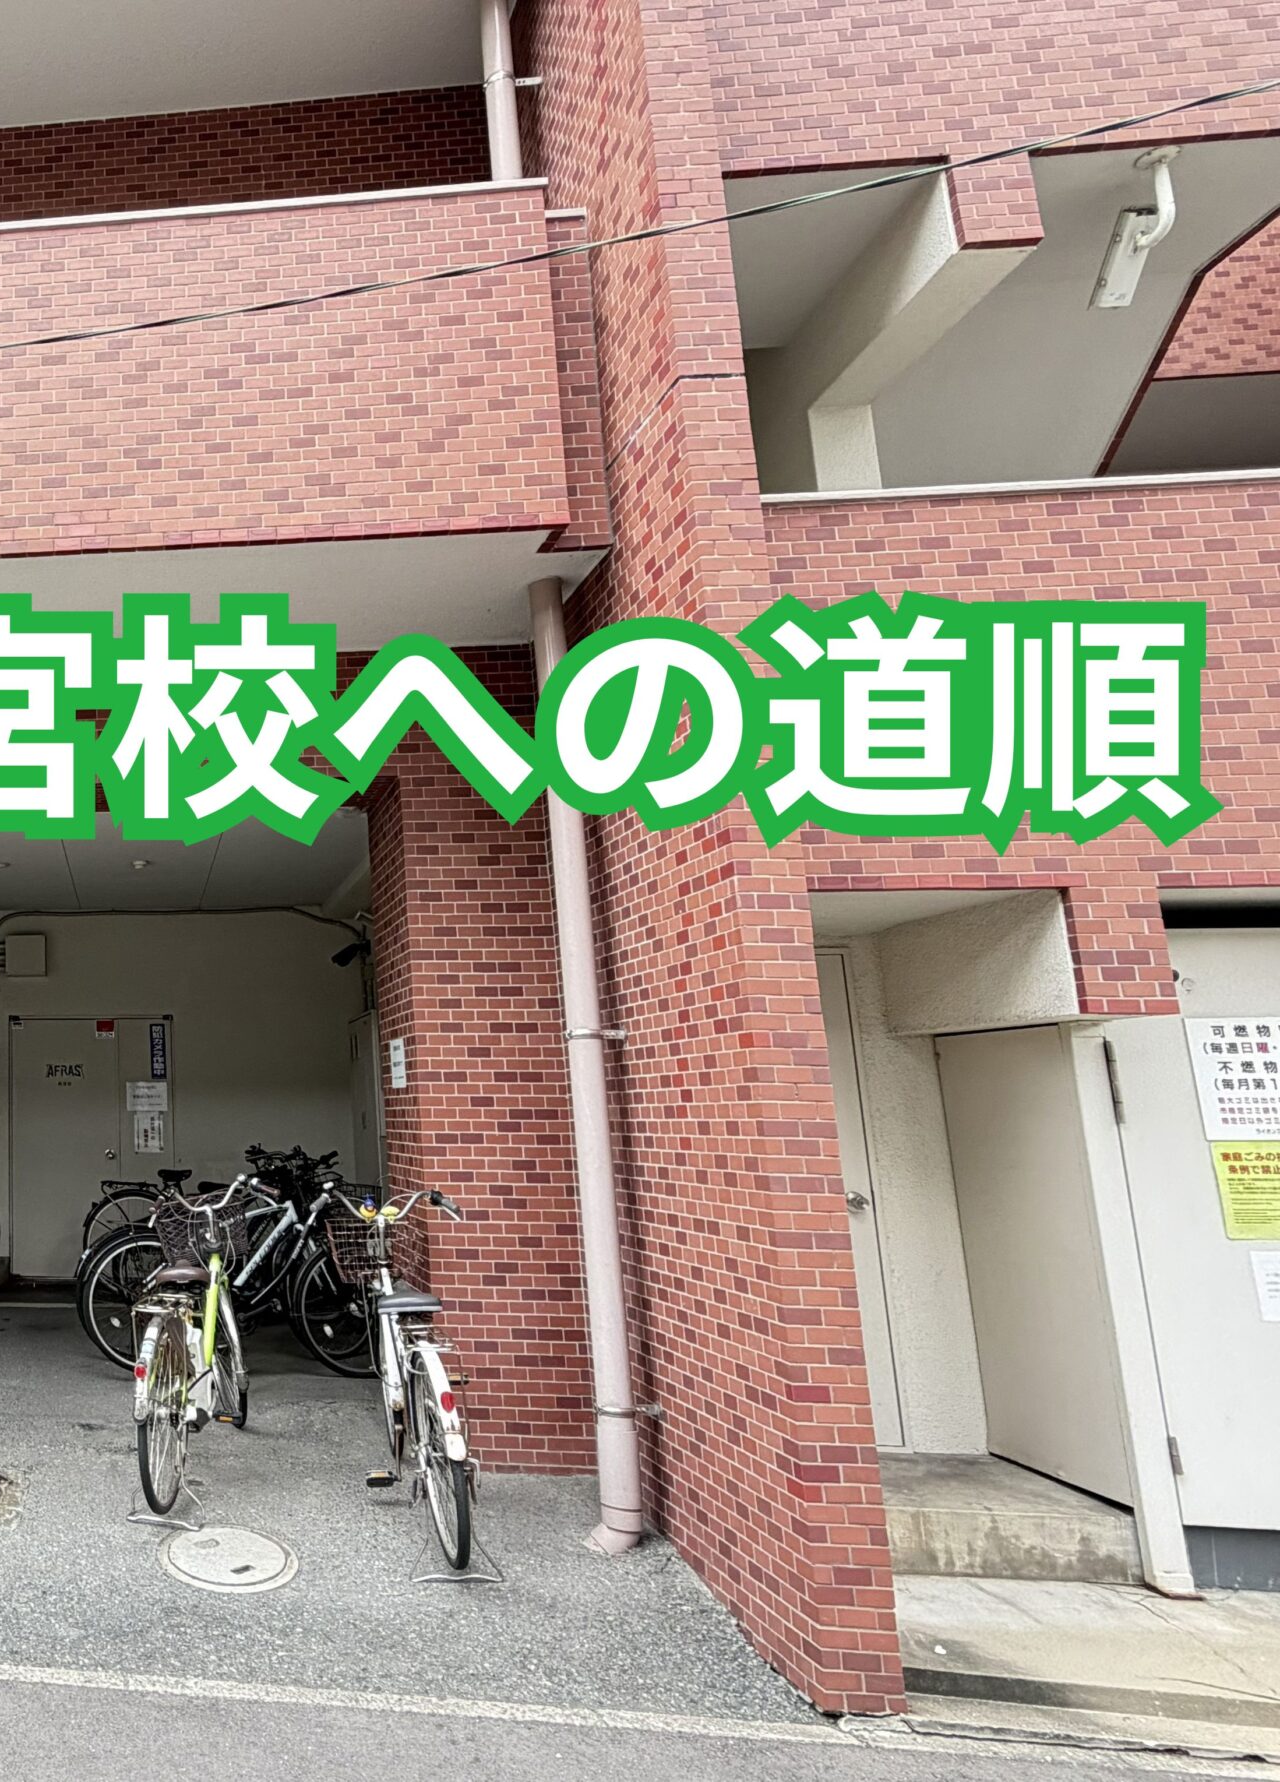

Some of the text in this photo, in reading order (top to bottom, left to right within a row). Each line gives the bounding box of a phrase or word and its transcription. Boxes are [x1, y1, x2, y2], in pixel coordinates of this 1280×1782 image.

[1210, 1025, 1280, 1038] 可燃物
[46, 1064, 84, 1079] AFRAS
[1217, 1061, 1278, 1074] 不燃物
